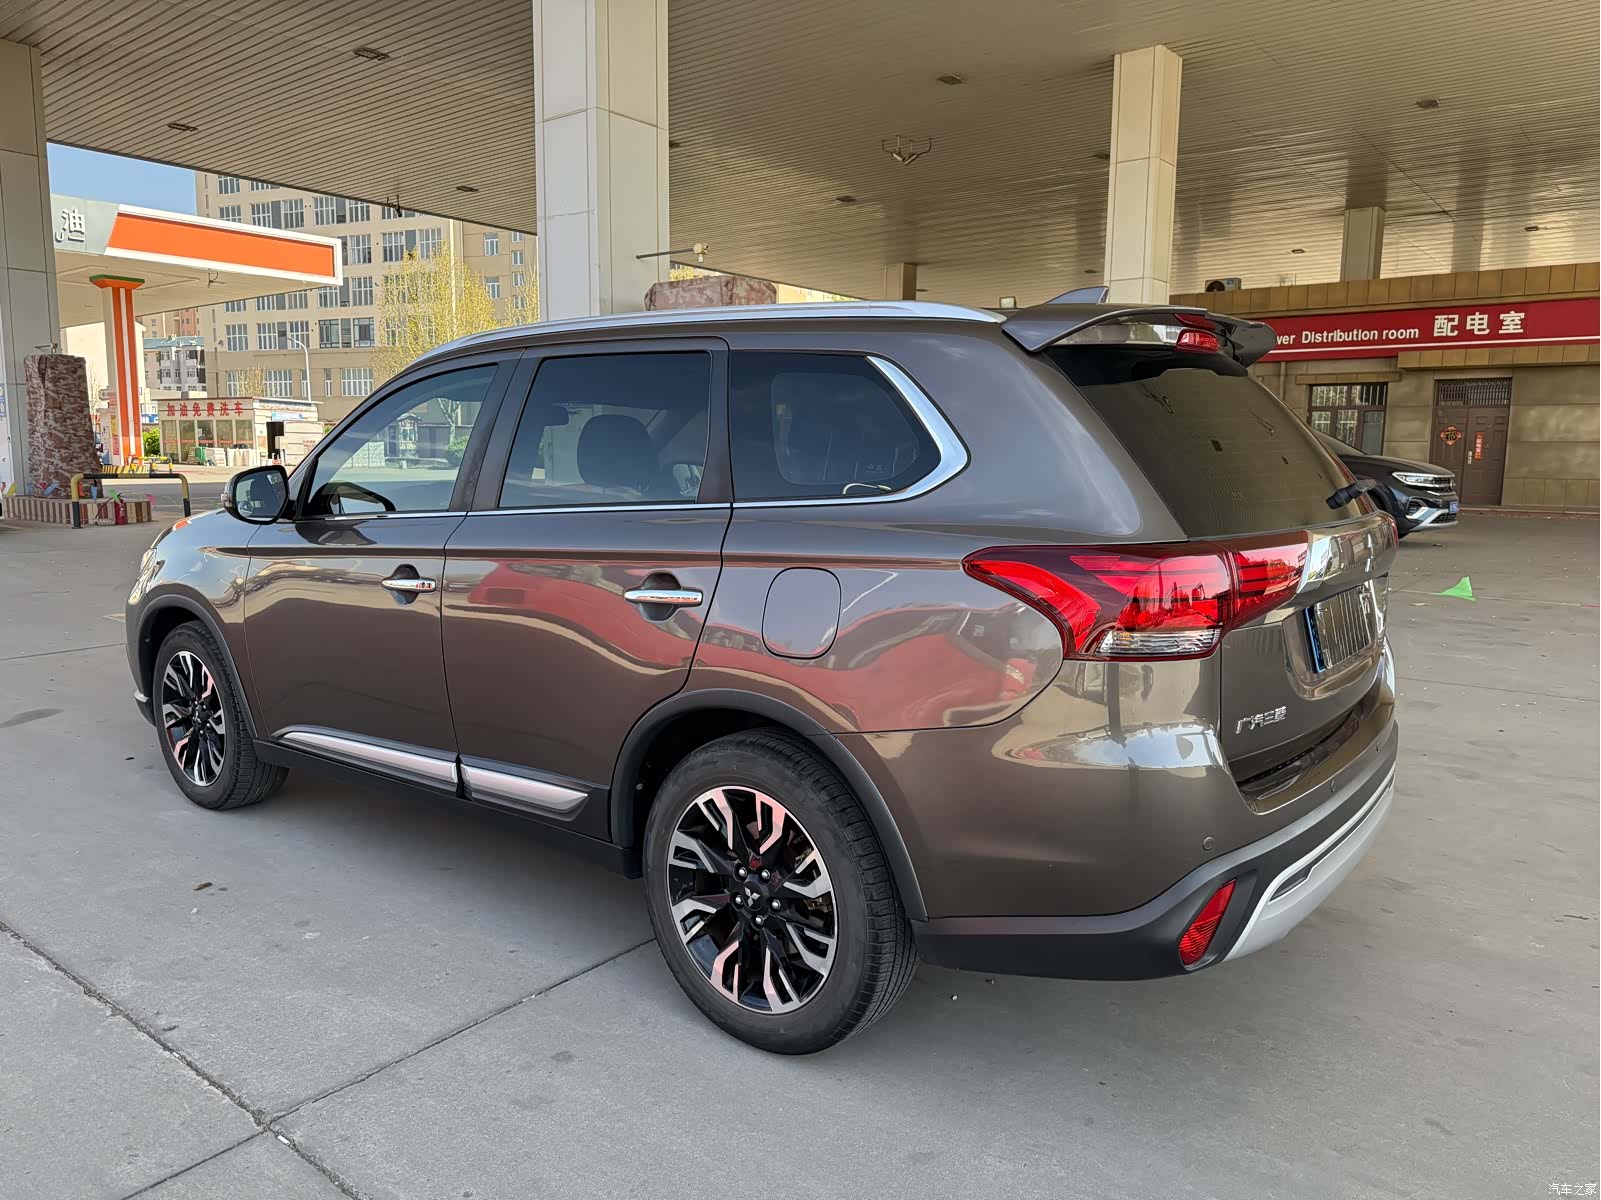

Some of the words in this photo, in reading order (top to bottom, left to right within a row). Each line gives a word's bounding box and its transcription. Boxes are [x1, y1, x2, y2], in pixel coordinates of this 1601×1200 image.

[54, 208, 86, 243] 油
[1433, 310, 1526, 337] 配电室
[1301, 328, 1379, 344] Distribution
[1382, 328, 1419, 341] room
[166, 401, 244, 417] 加油免费洗车
